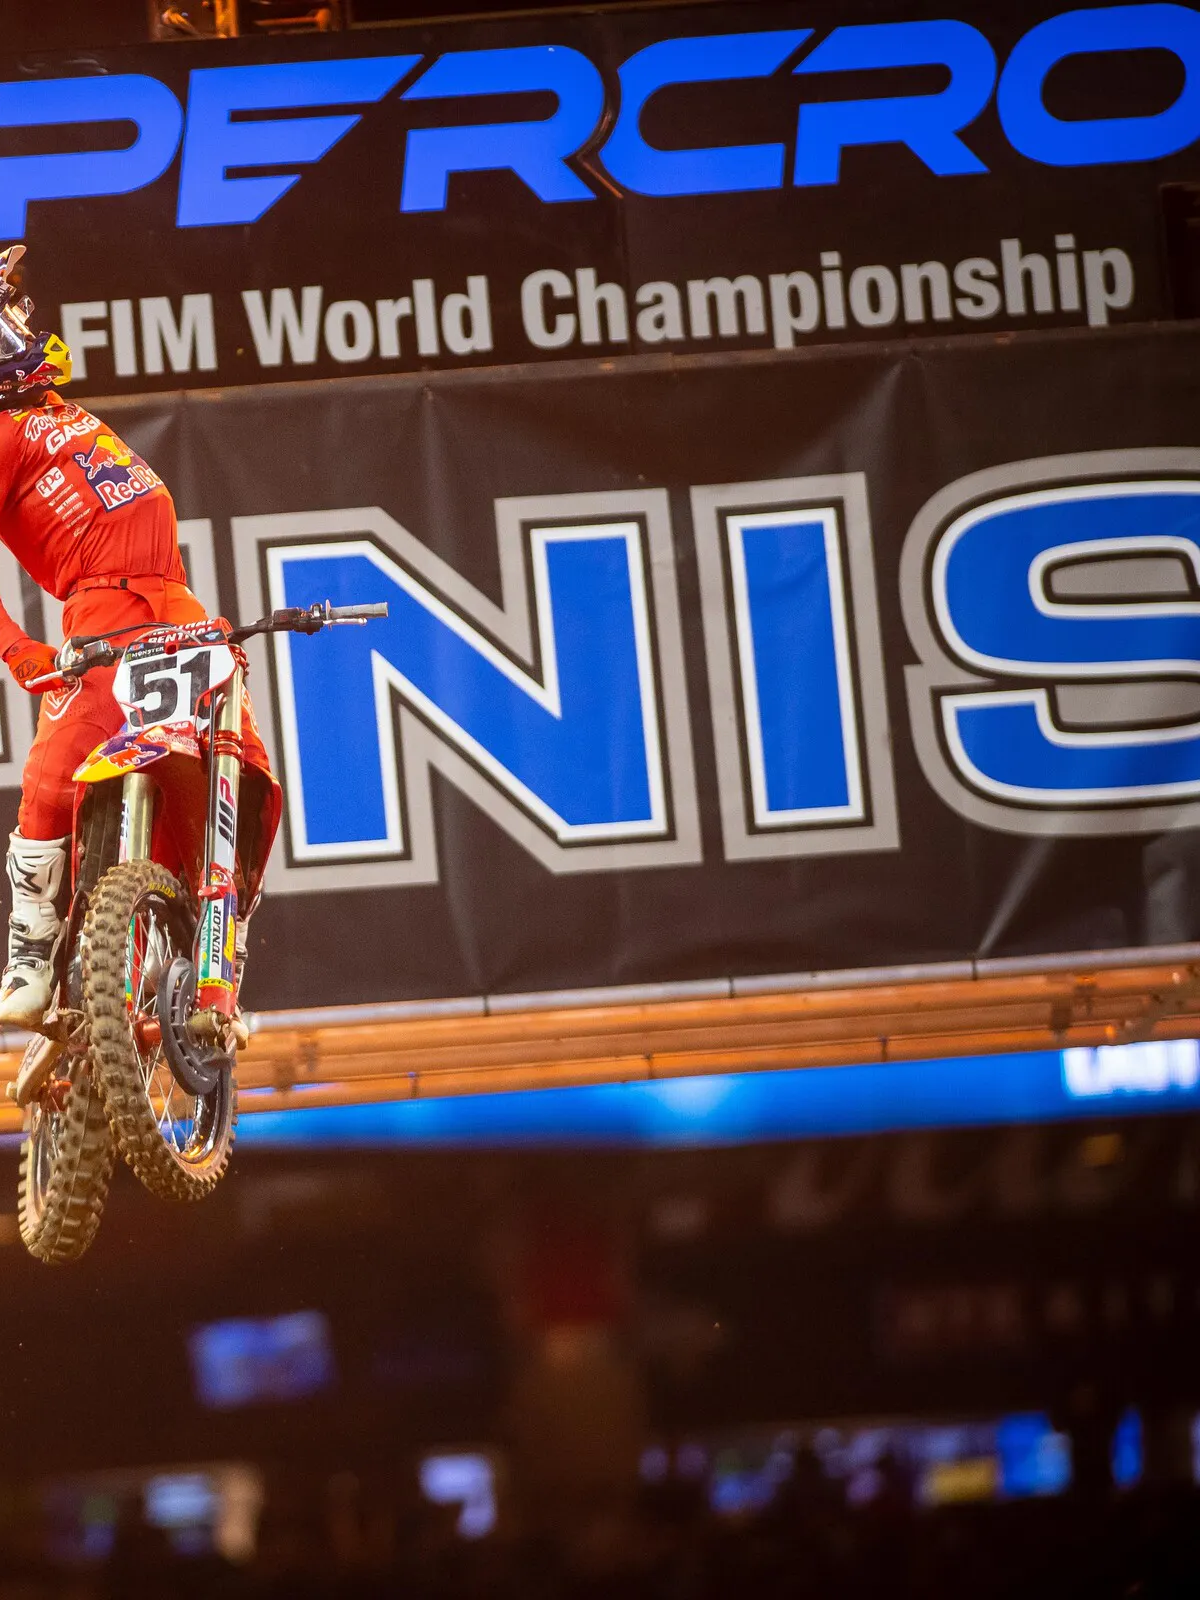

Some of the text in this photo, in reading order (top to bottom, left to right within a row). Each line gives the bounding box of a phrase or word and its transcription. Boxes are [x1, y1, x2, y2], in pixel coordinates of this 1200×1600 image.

[61, 233, 1136, 381] FIM World Championship
[45, 415, 101, 455] GASG
[37, 469, 62, 495] PPG
[95, 466, 148, 510] Red
[133, 464, 166, 489] Bu
[131, 646, 164, 658] MONSTER
[128, 650, 212, 727] 51
[211, 905, 222, 966] DUNLOP
